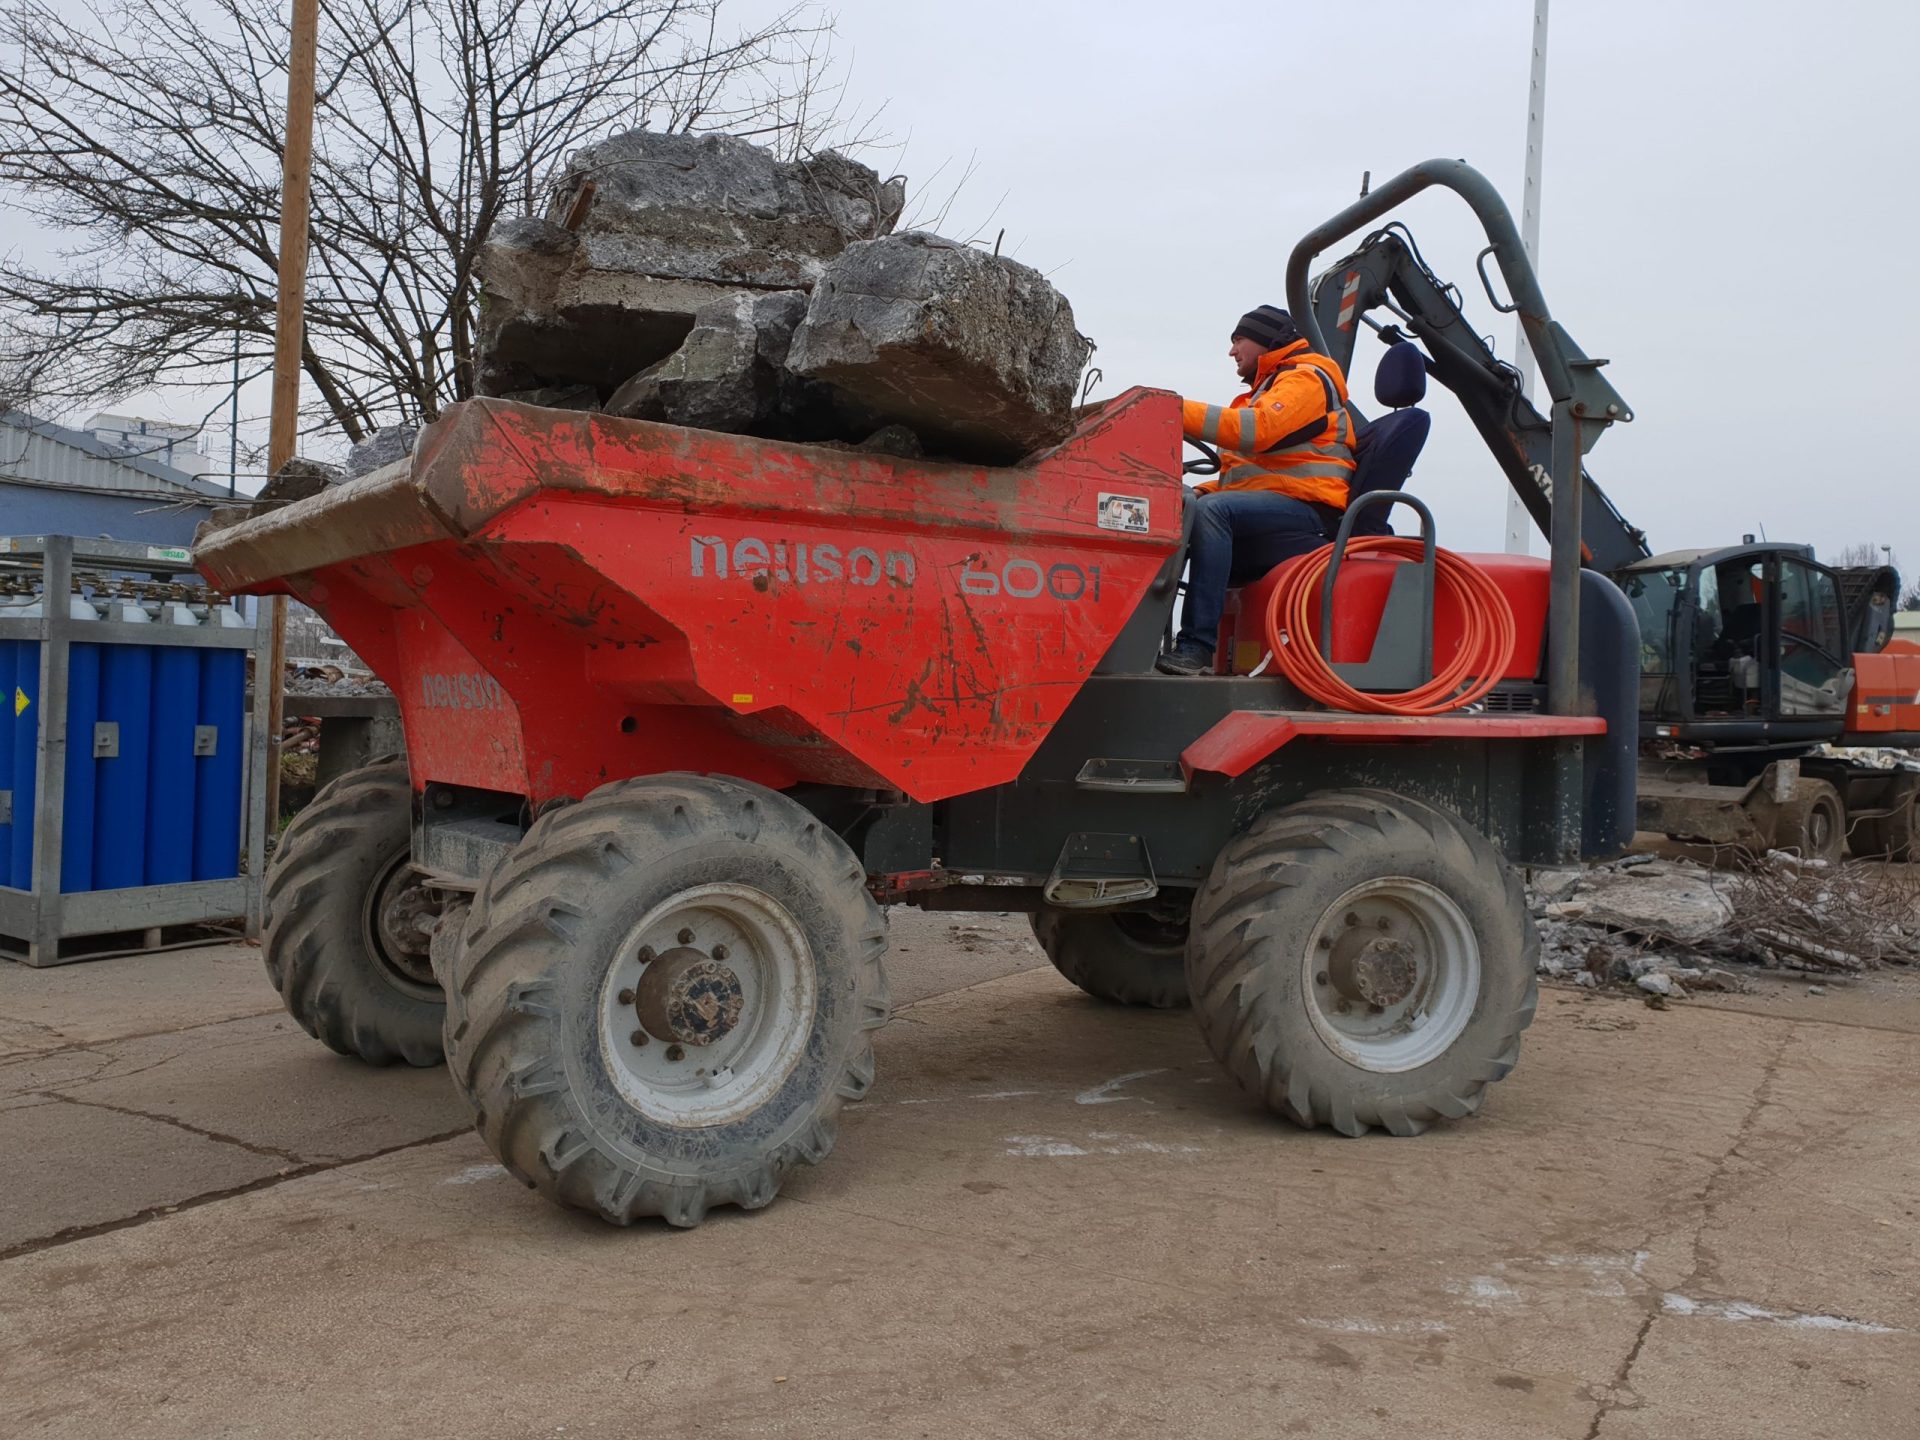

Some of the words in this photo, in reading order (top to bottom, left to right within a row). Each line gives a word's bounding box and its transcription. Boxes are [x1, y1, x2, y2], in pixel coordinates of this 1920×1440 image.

[690, 536, 916, 588] neuson
[960, 557, 1100, 602] 6001
[422, 671, 503, 711] neuson
